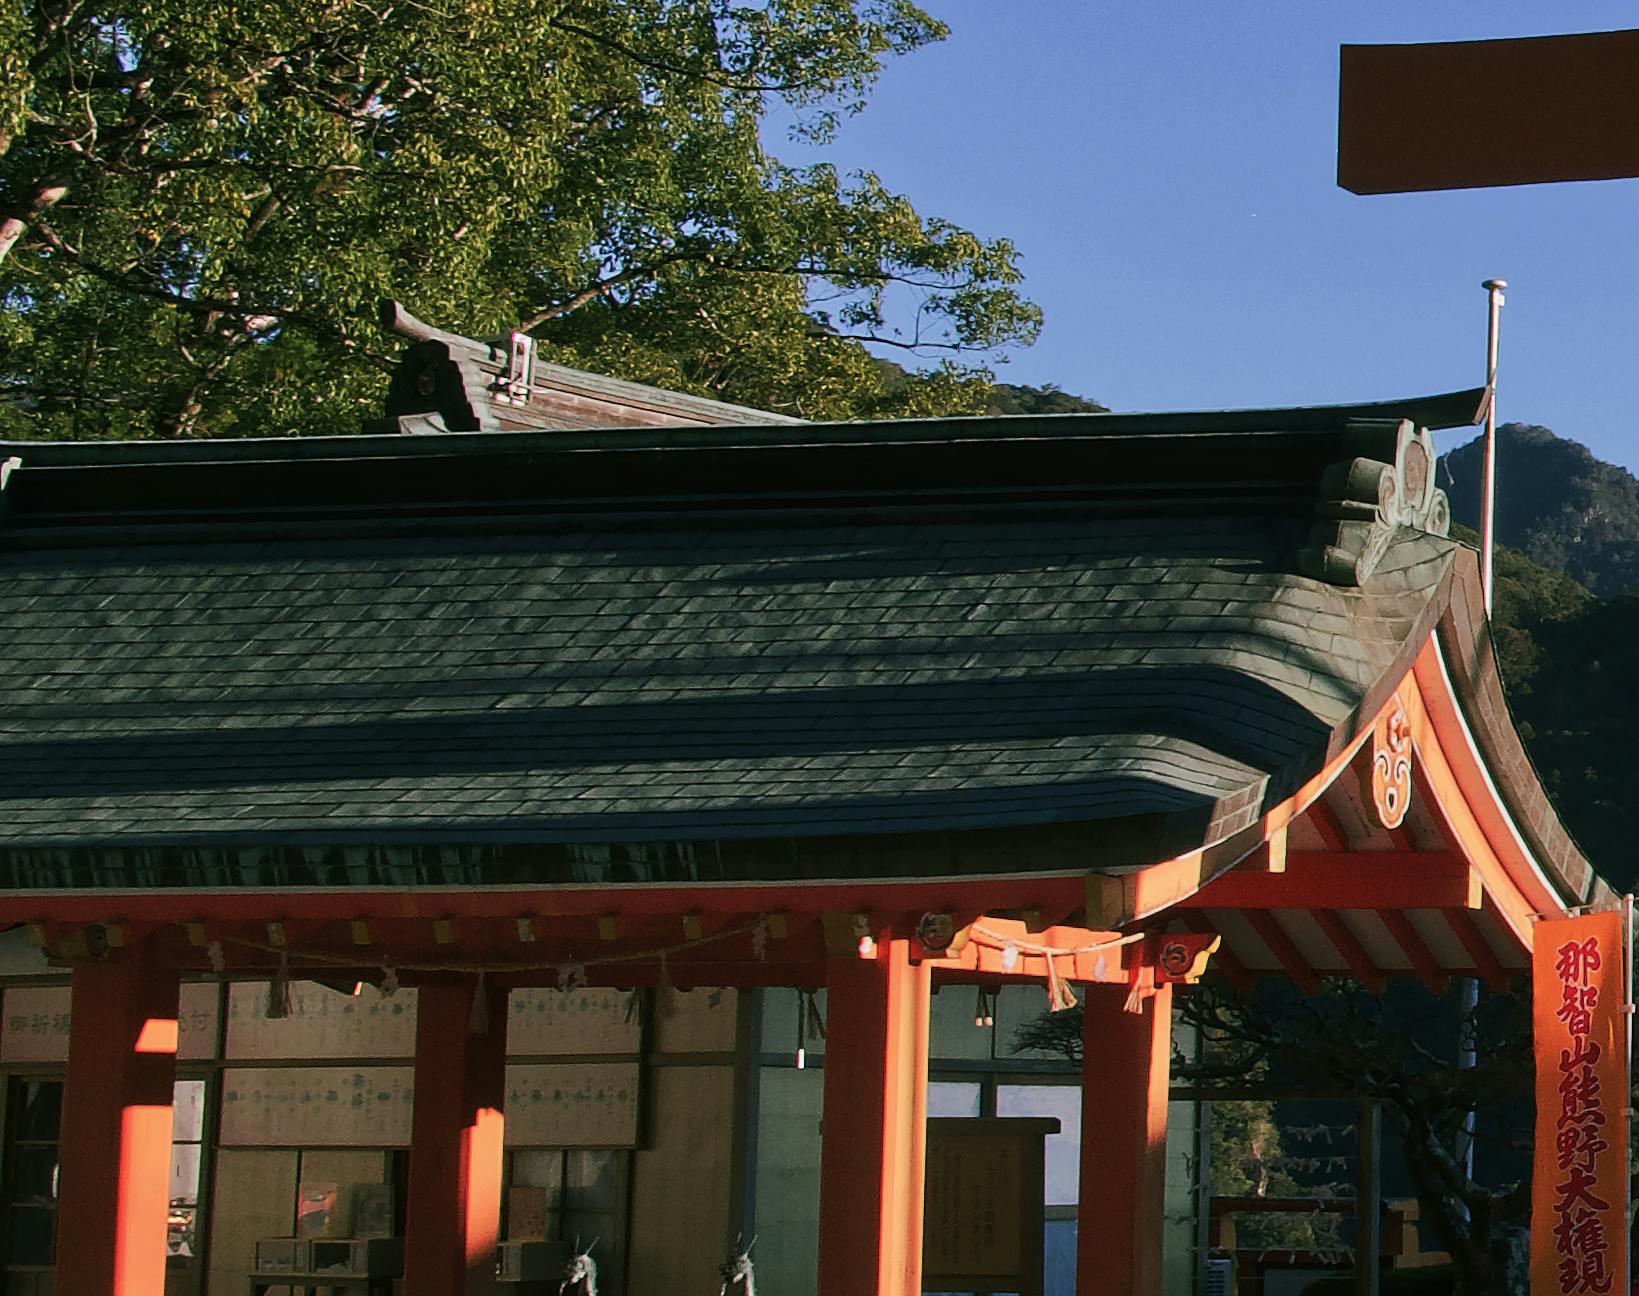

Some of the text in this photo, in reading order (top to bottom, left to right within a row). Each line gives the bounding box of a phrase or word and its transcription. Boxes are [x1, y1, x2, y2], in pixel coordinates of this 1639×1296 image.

[1554, 937, 1614, 1295] 那智山熊野大権現
